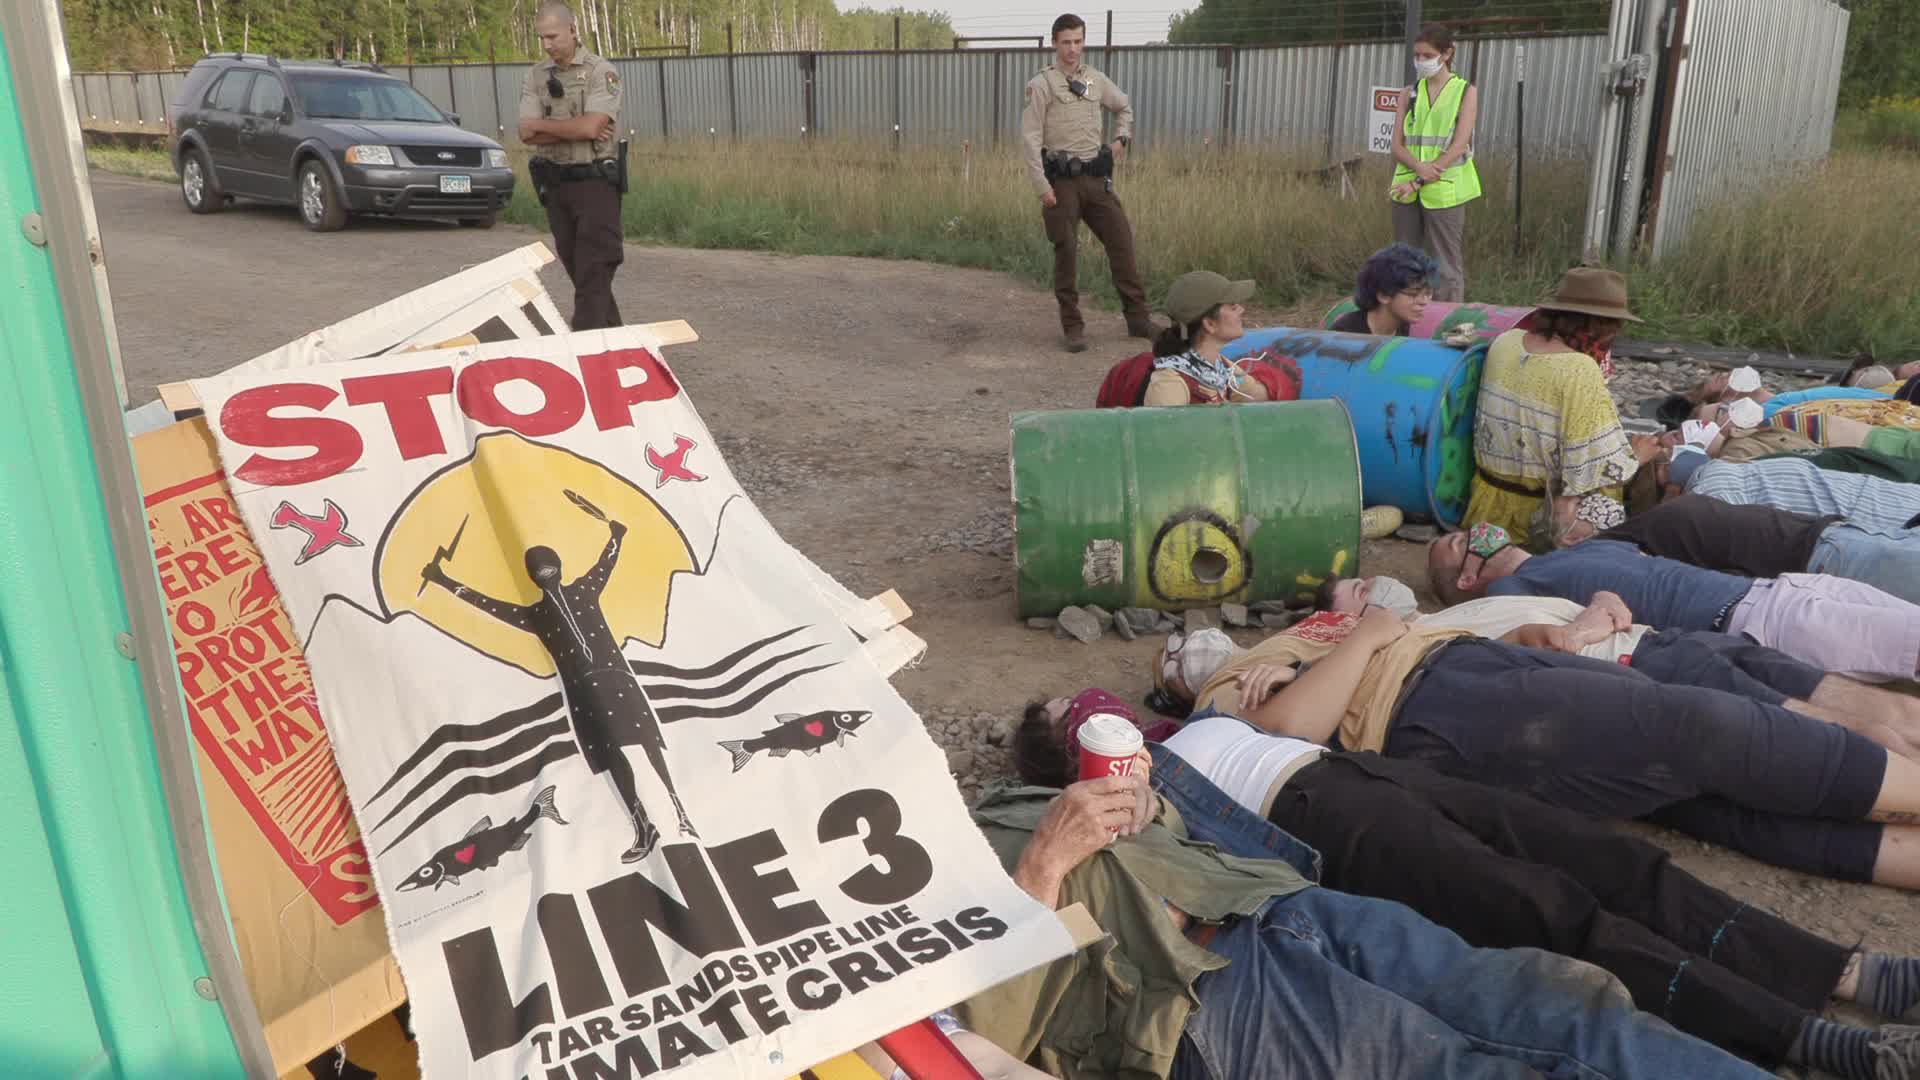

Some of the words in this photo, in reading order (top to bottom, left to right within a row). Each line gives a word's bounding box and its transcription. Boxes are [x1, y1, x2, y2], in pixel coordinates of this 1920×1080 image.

[1381, 95, 1400, 107] DA
[1373, 136, 1392, 150] POW
[219, 347, 681, 487] STOP
[180, 497, 241, 543] AR
[158, 534, 253, 601] ERE
[177, 608, 292, 700] PROT
[196, 657, 307, 736] THE
[224, 697, 327, 777] WAT
[441, 828, 832, 1062] LINE
[817, 788, 934, 906] 3
[518, 984, 792, 1080] MATE
[785, 906, 1009, 1012] CRISIS
[530, 1015, 621, 1065] TAR
[620, 954, 758, 1025] SANDS
